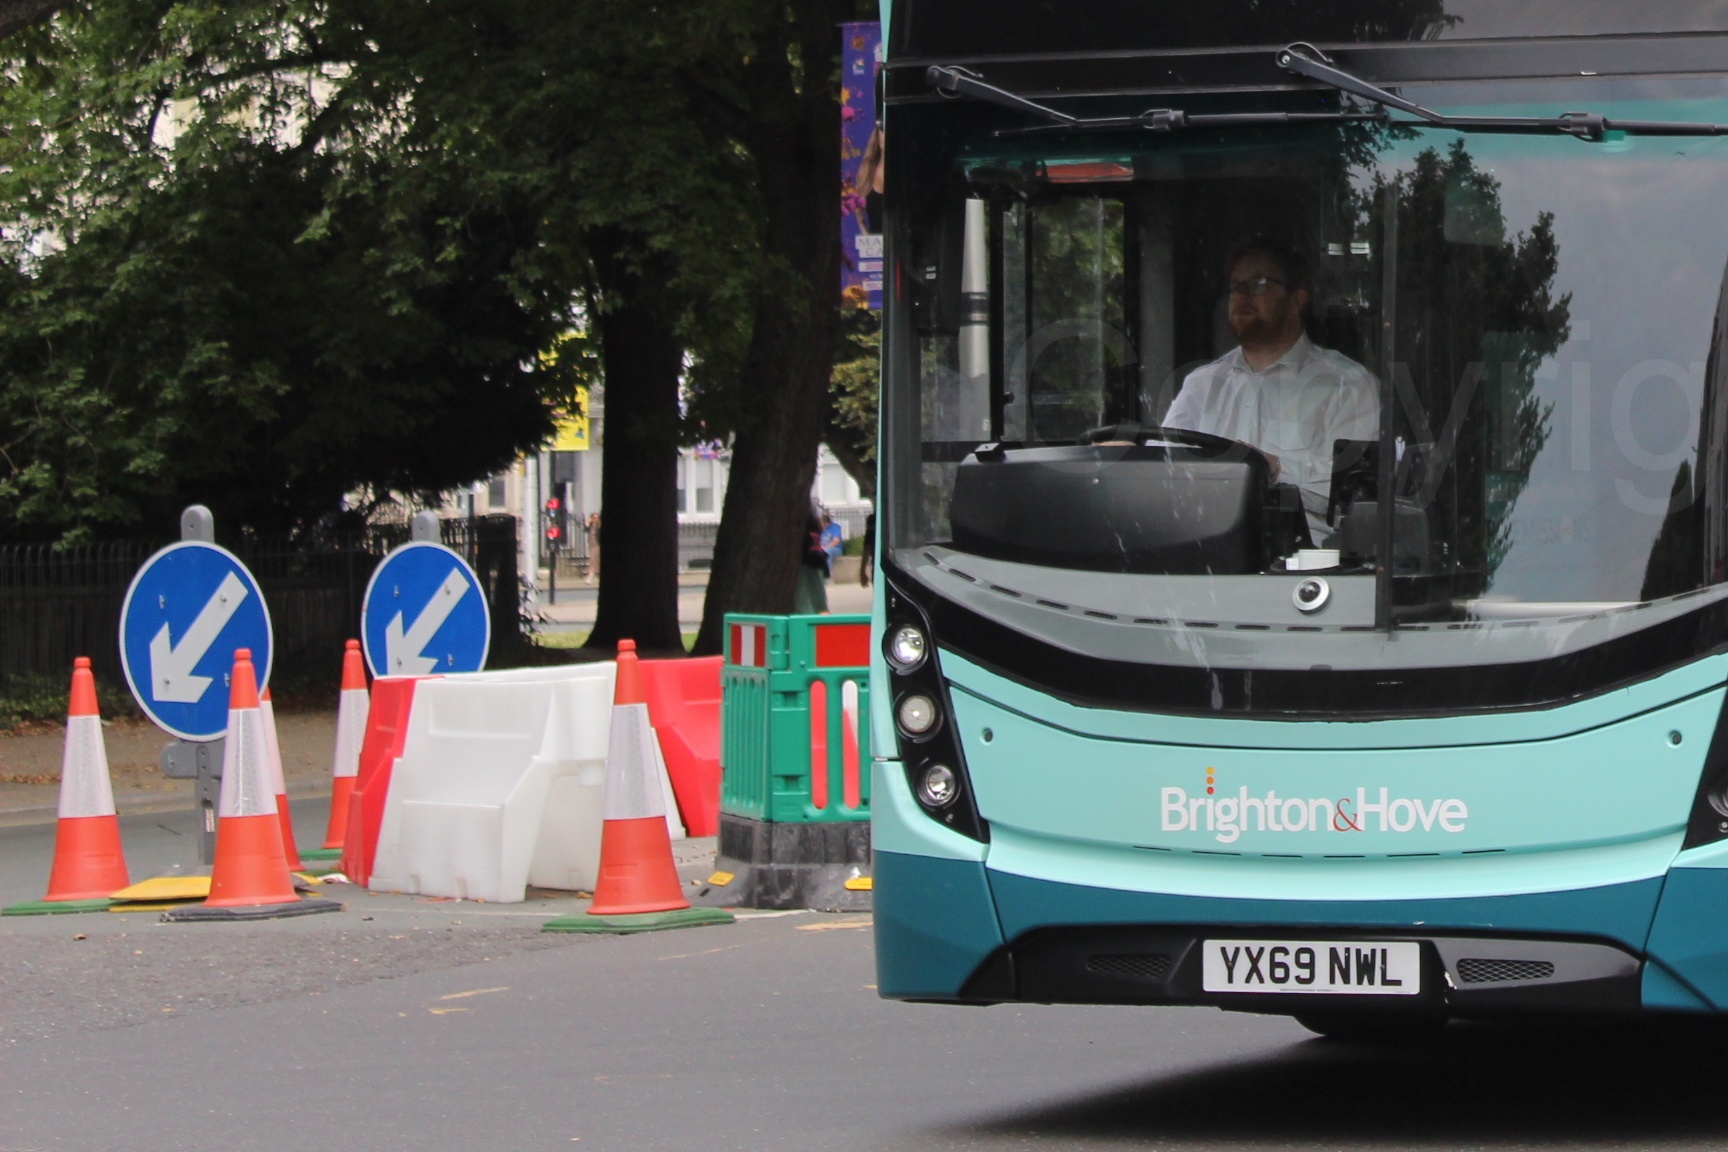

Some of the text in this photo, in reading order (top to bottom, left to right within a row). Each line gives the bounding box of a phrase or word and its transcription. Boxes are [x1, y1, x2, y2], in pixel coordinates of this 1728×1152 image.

[1160, 767, 1468, 844] Brighton&Hove
[1220, 947, 1402, 986] YX69 NWL
